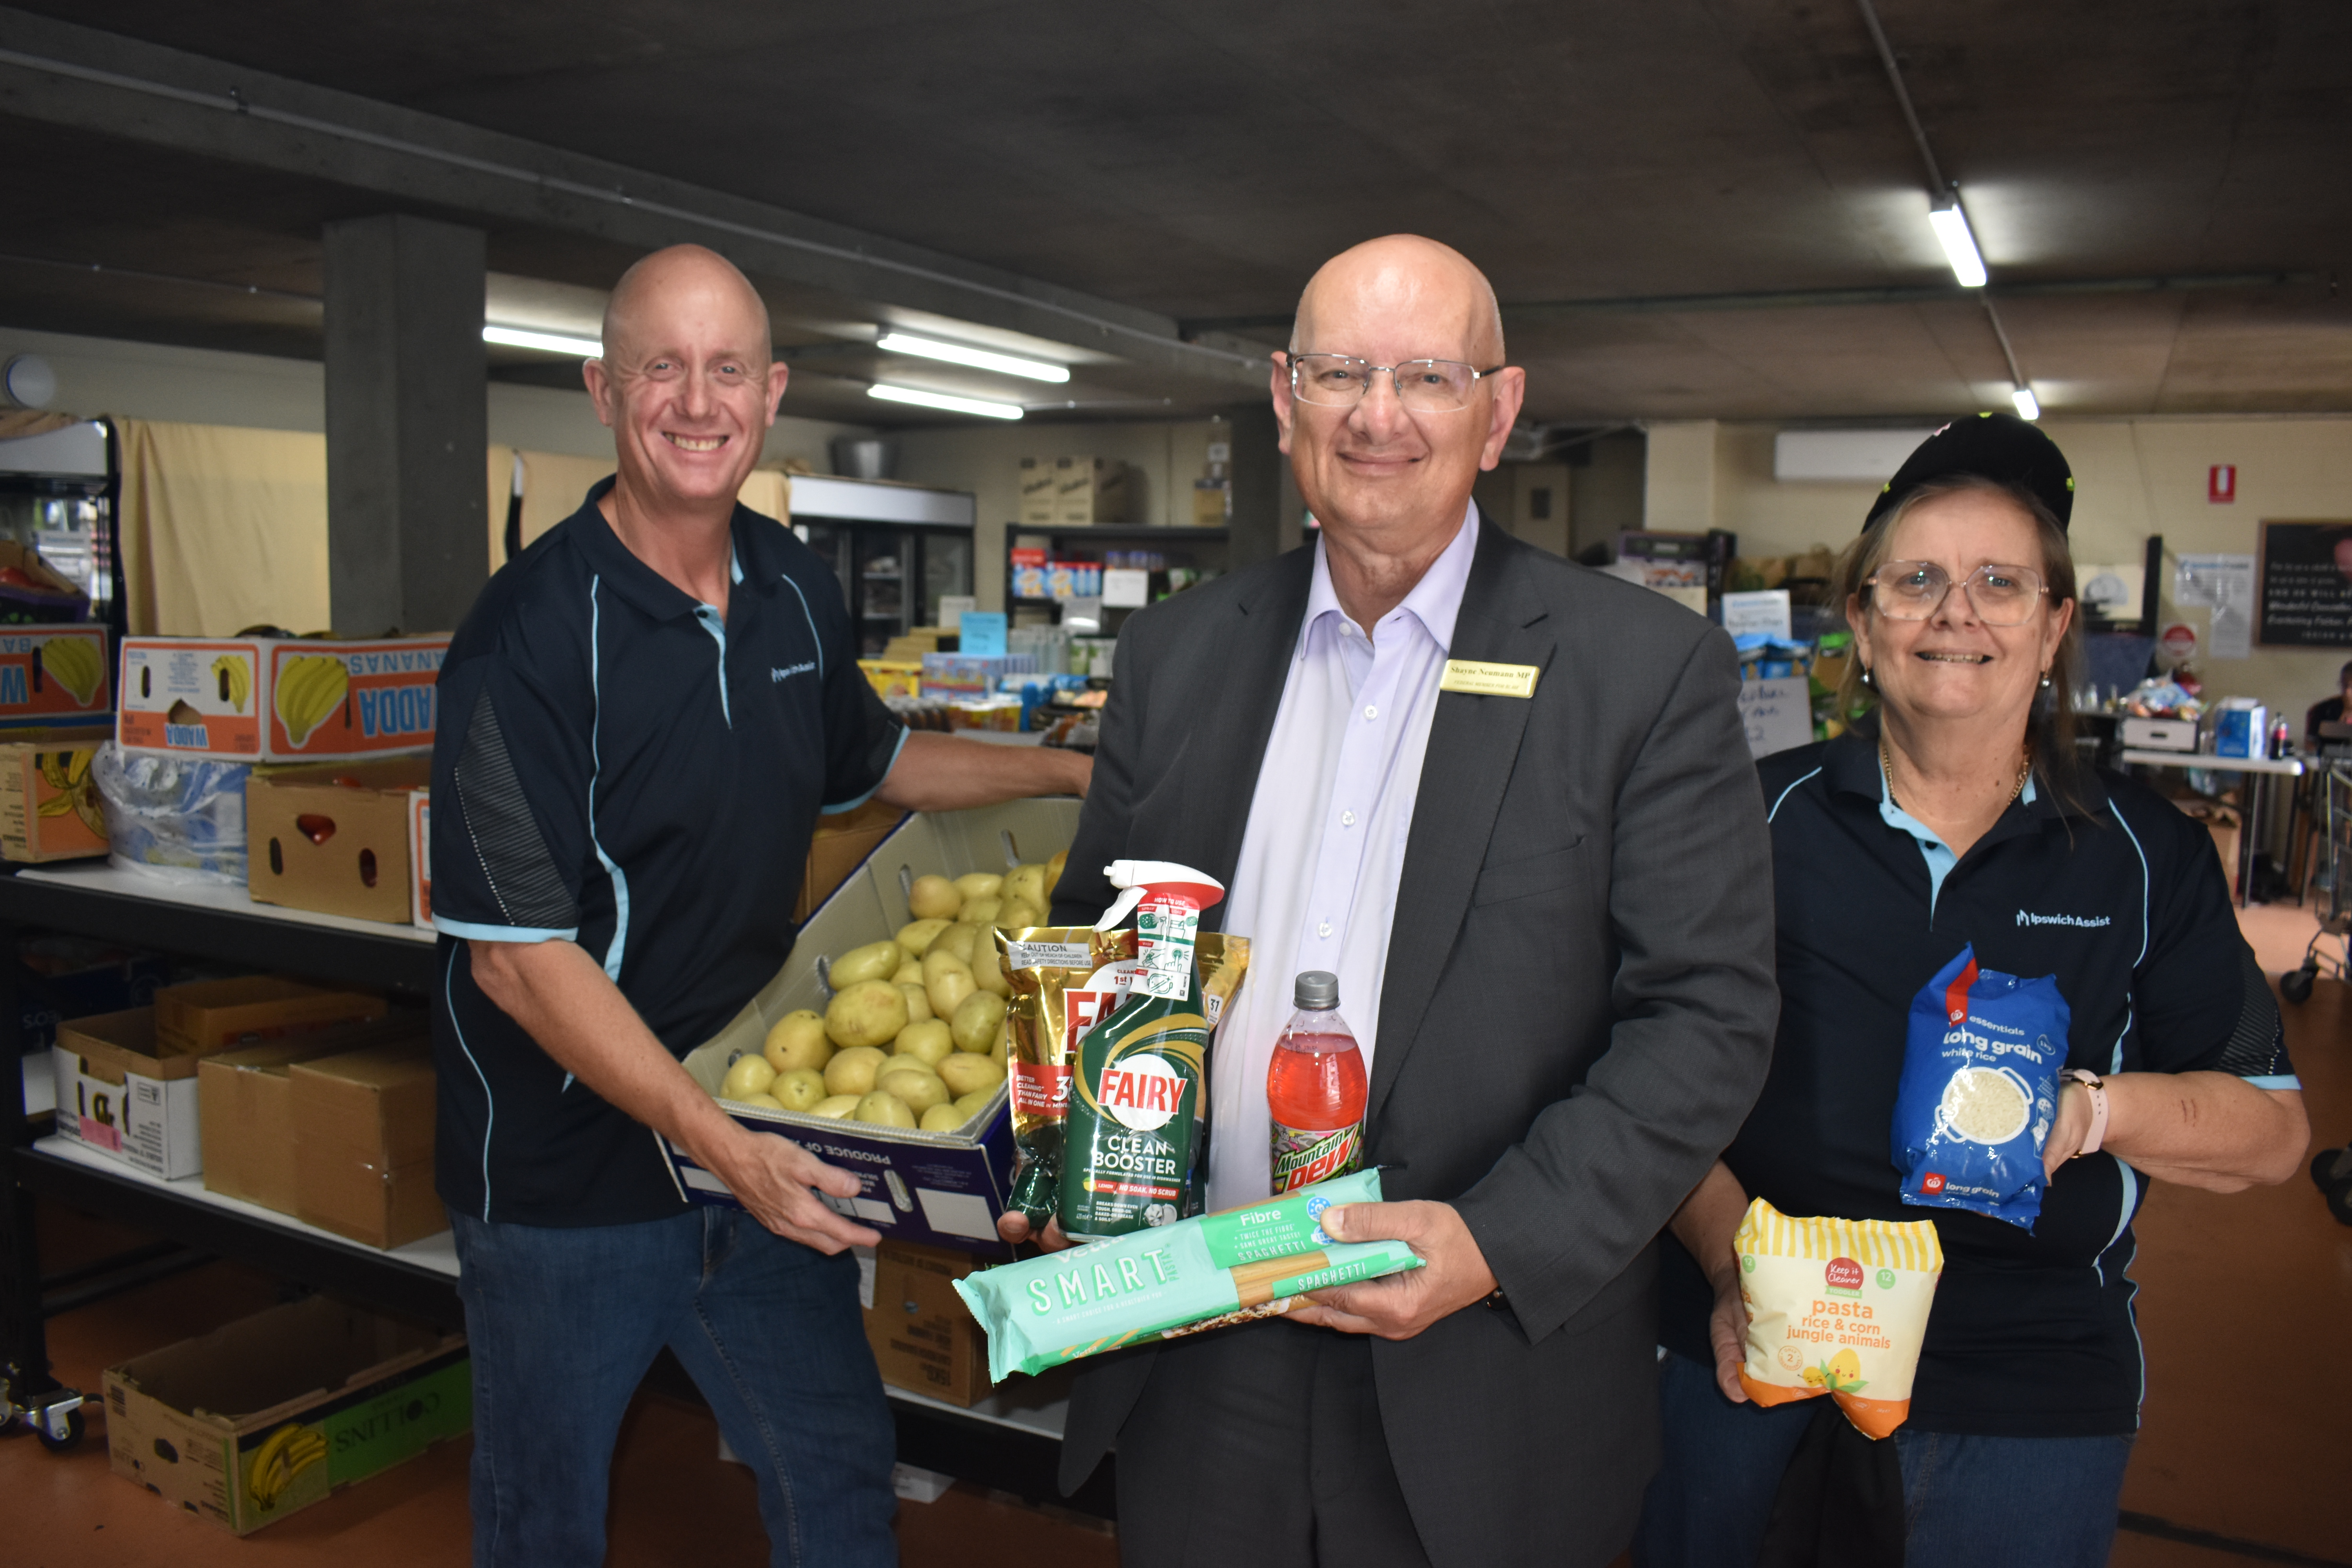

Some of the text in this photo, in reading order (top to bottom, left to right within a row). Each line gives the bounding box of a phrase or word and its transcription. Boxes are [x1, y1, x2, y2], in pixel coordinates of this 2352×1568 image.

[350, 652, 447, 674] ANANAS
[1451, 666, 1477, 675] Shayne
[1480, 668, 1514, 678] Neumann
[358, 687, 431, 735] ADDA
[1114, 976, 1127, 985] 1st
[1210, 998, 1220, 1012] 31
[1969, 1015, 2025, 1036] essentials
[1942, 1047, 1997, 1062] white rice
[1943, 1031, 2042, 1065] long grain
[1032, 1092, 1048, 1100] FAIRY
[1098, 1069, 1187, 1114] FAIRY
[1281, 1132, 1289, 1140] 600
[806, 1143, 892, 1165] PRODUCE OF
[1107, 1136, 1167, 1156] CLEAN
[1276, 1132, 1344, 1174] Mountain
[1093, 1151, 1176, 1175] BOOSTER
[1129, 1185, 1147, 1194] SOAK,
[1945, 1182, 1970, 1193] long
[1971, 1187, 2000, 1198] grain
[1240, 1209, 1281, 1226] Fibre
[1240, 1230, 1259, 1240] TWICE
[1261, 1228, 1273, 1236] THE
[1240, 1231, 1301, 1249] SAME GREAT TASTE!
[1238, 1240, 1307, 1261] SPAGHETTI
[1161, 1252, 1180, 1282] PASTA
[1298, 1262, 1367, 1291] SPAGHETTI
[1830, 1263, 1849, 1277] Keep
[1880, 1271, 1892, 1282] 12
[1027, 1248, 1167, 1316] SMART
[1828, 1273, 1860, 1284] Cleaner
[1829, 1288, 1861, 1297] TODDLER
[1062, 1313, 1080, 1323] SMART
[1082, 1307, 1102, 1318] CHOICE
[1103, 1304, 1114, 1312] FOR
[1120, 1294, 1151, 1307] HEALTHIER
[1151, 1291, 1163, 1300] YOU
[1811, 1299, 1873, 1319] pasta
[1802, 1315, 1881, 1335] rice & corn
[1786, 1325, 1891, 1349] jungle animals
[1071, 1345, 1098, 1359] Vetta
[1788, 1354, 1793, 1362] 2
